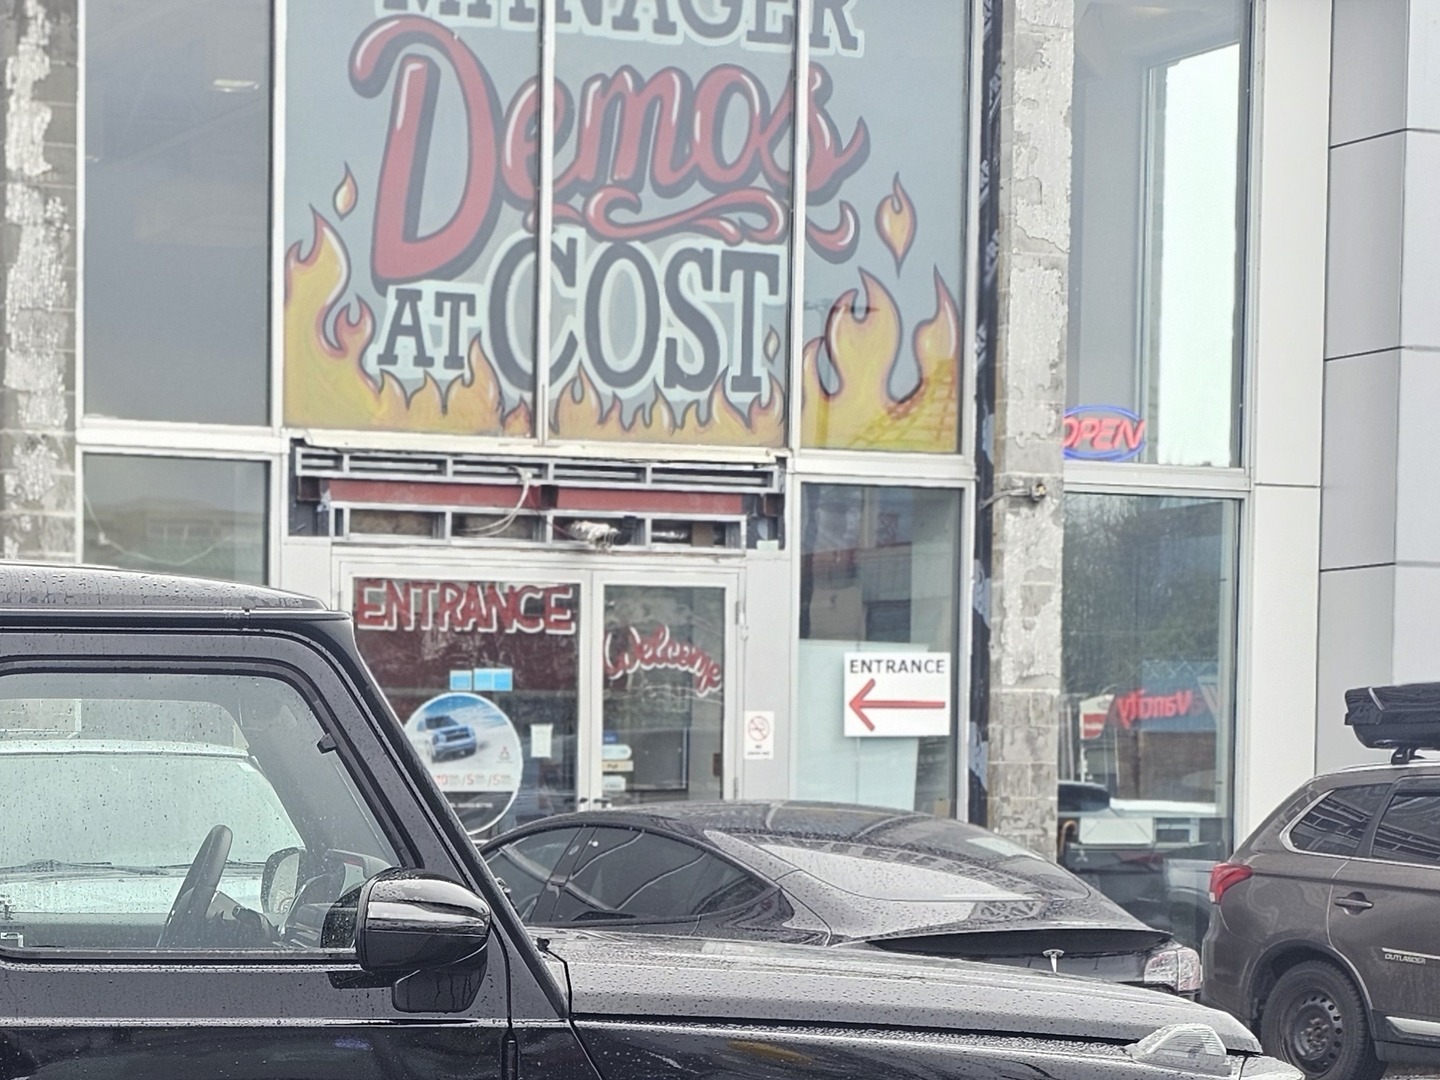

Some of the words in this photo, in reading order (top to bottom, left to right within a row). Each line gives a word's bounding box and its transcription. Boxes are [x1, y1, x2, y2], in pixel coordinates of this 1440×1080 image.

[349, 15, 869, 286] Demos
[377, 288, 477, 370] AT
[488, 235, 780, 394] COST
[1062, 416, 1145, 450] OPEN
[355, 579, 576, 635] ENTRANCE
[603, 623, 723, 698] Welcome
[849, 659, 946, 675] ENTRANCE
[1384, 953, 1426, 965] OUTLANDER
